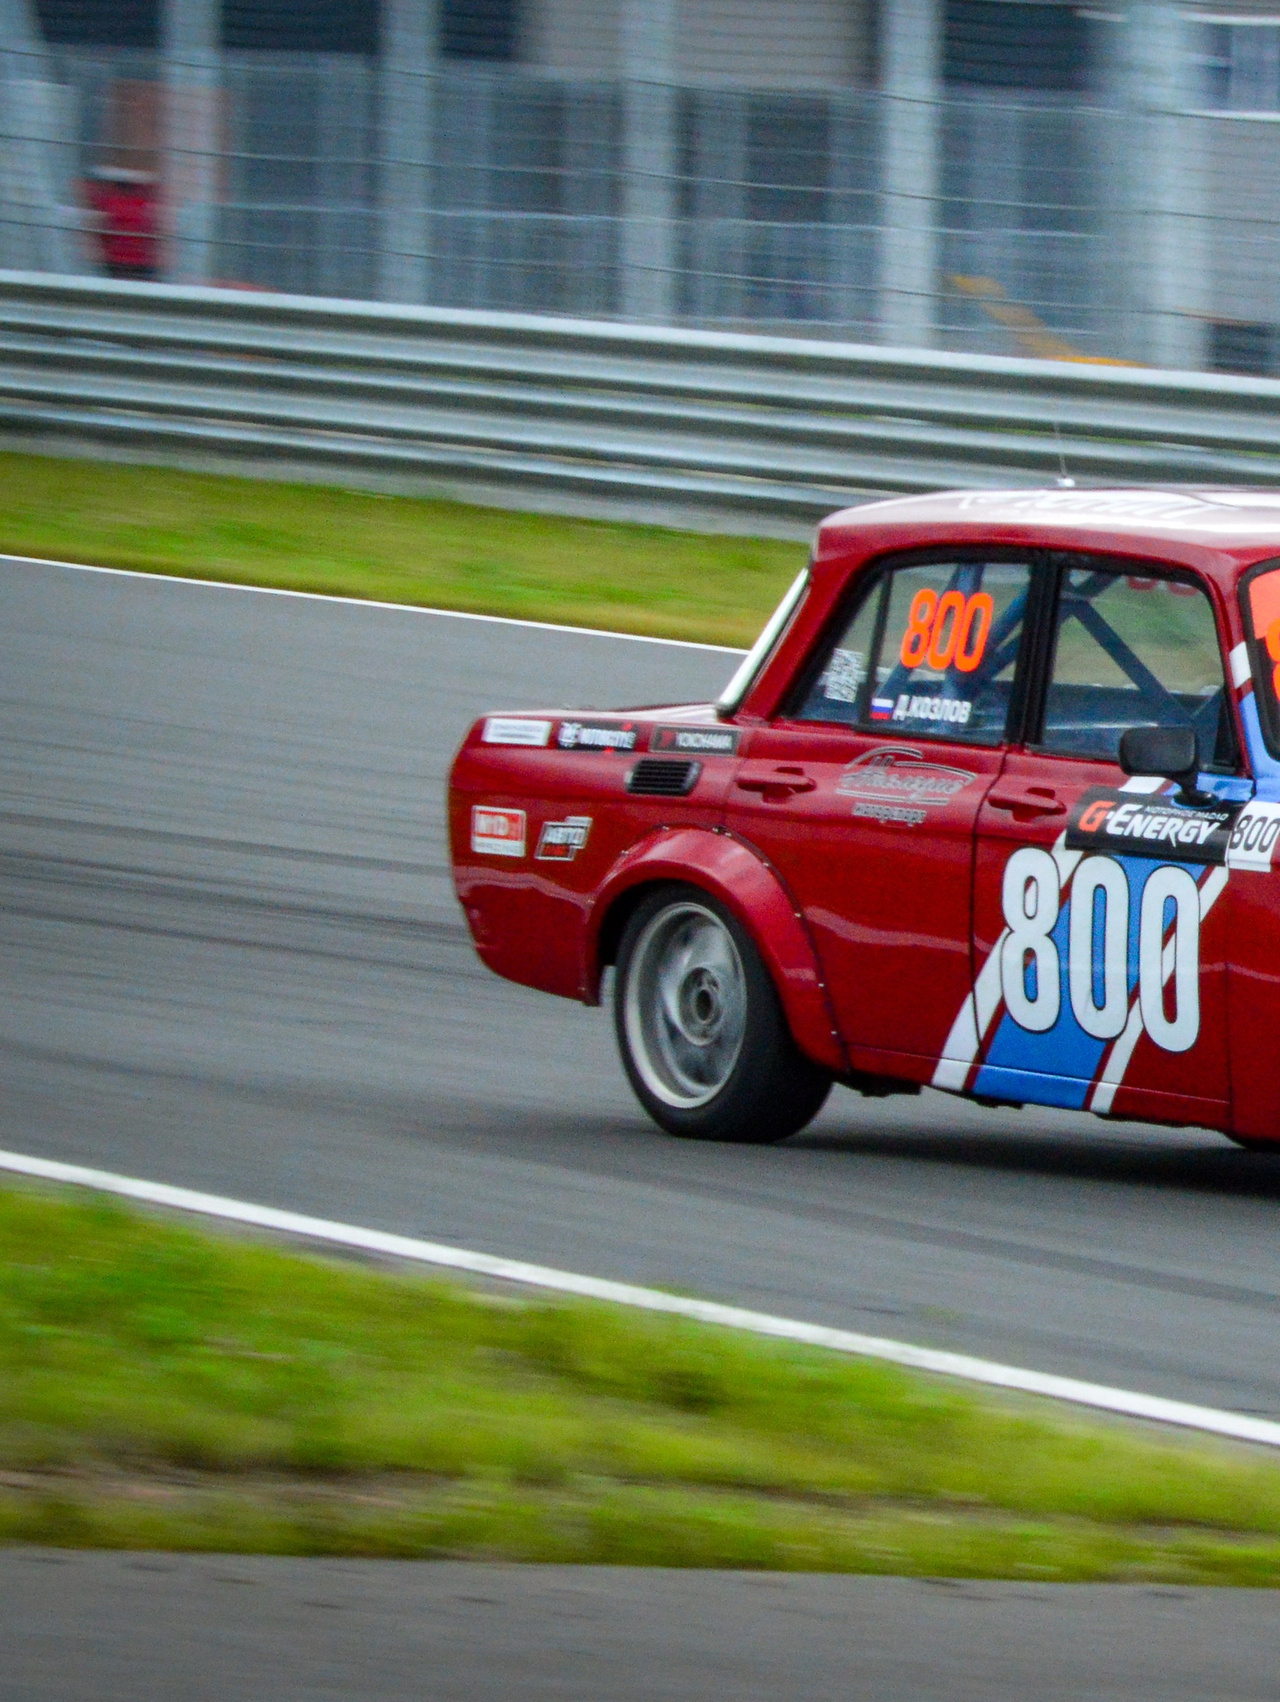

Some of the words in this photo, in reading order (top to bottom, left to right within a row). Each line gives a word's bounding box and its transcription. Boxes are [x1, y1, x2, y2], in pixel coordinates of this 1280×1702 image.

[900, 588, 994, 672] 800
[893, 694, 972, 723] Д.КОЗЛОВ
[1000, 847, 1200, 1052] 800
